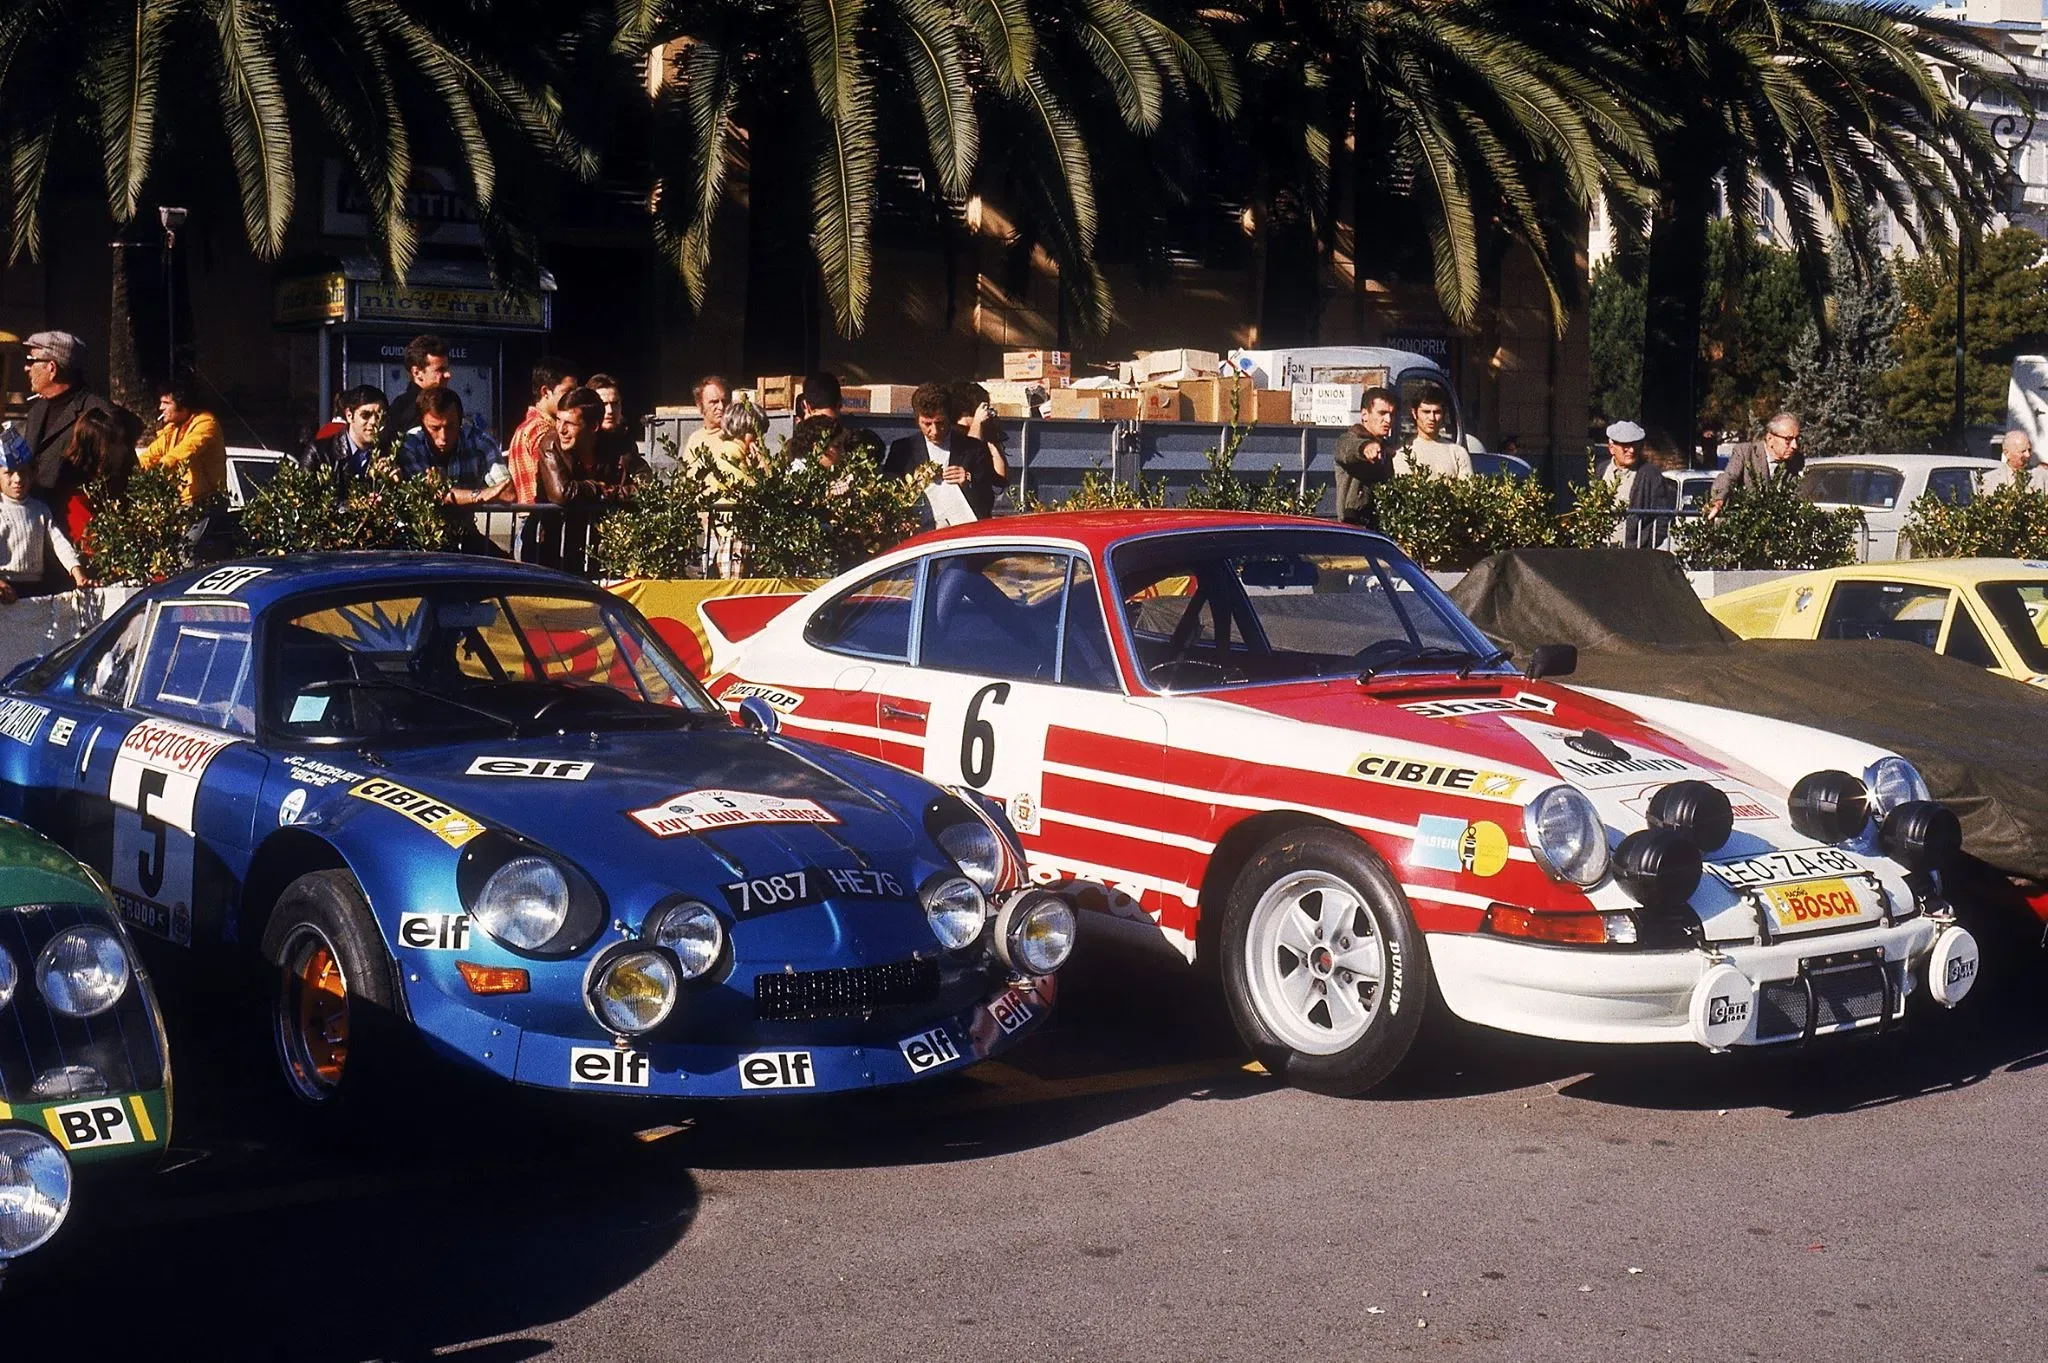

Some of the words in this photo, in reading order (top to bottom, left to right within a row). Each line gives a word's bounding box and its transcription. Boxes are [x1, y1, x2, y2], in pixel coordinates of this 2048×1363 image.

[381, 345, 406, 357] GUID
[1386, 337, 1447, 355] MONOPRIX
[1318, 389, 1345, 398] UNION
[1316, 415, 1343, 424] UNION
[197, 568, 264, 591] elf
[732, 684, 798, 707] DUNLOP
[125, 724, 227, 774] aseprogyl
[960, 682, 1011, 789] 6
[478, 760, 583, 778] elf
[1555, 758, 1688, 778] Marlboro
[695, 810, 749, 824] TOUR
[752, 812, 767, 820] DE
[768, 809, 829, 821] CORSE
[713, 796, 736, 808] 5
[138, 768, 168, 898] 5
[728, 872, 809, 912] 7087
[1788, 891, 1859, 921] BOSCH
[402, 914, 470, 949] elf
[1388, 940, 1404, 1016] DUNLOP
[995, 991, 1030, 1029] elf
[904, 1031, 955, 1069] elf
[574, 1052, 649, 1084] elf
[743, 1052, 811, 1085] elf
[59, 1106, 124, 1145] BP
